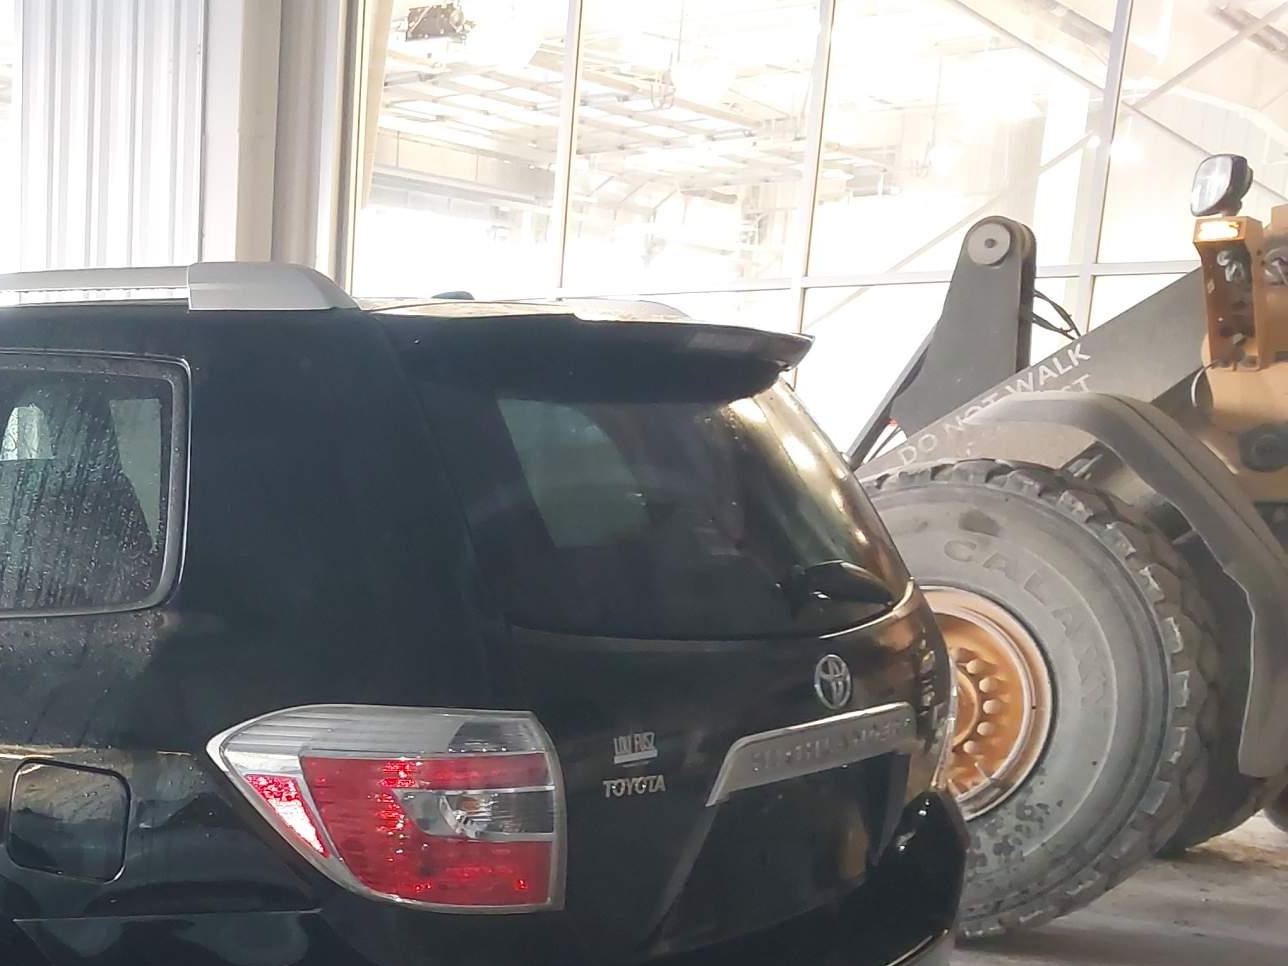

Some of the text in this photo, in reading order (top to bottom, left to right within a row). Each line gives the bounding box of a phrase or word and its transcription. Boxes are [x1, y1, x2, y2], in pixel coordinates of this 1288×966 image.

[897, 433, 938, 465] DO
[1006, 343, 1092, 393] WALK
[602, 774, 666, 798] TOYOTA
